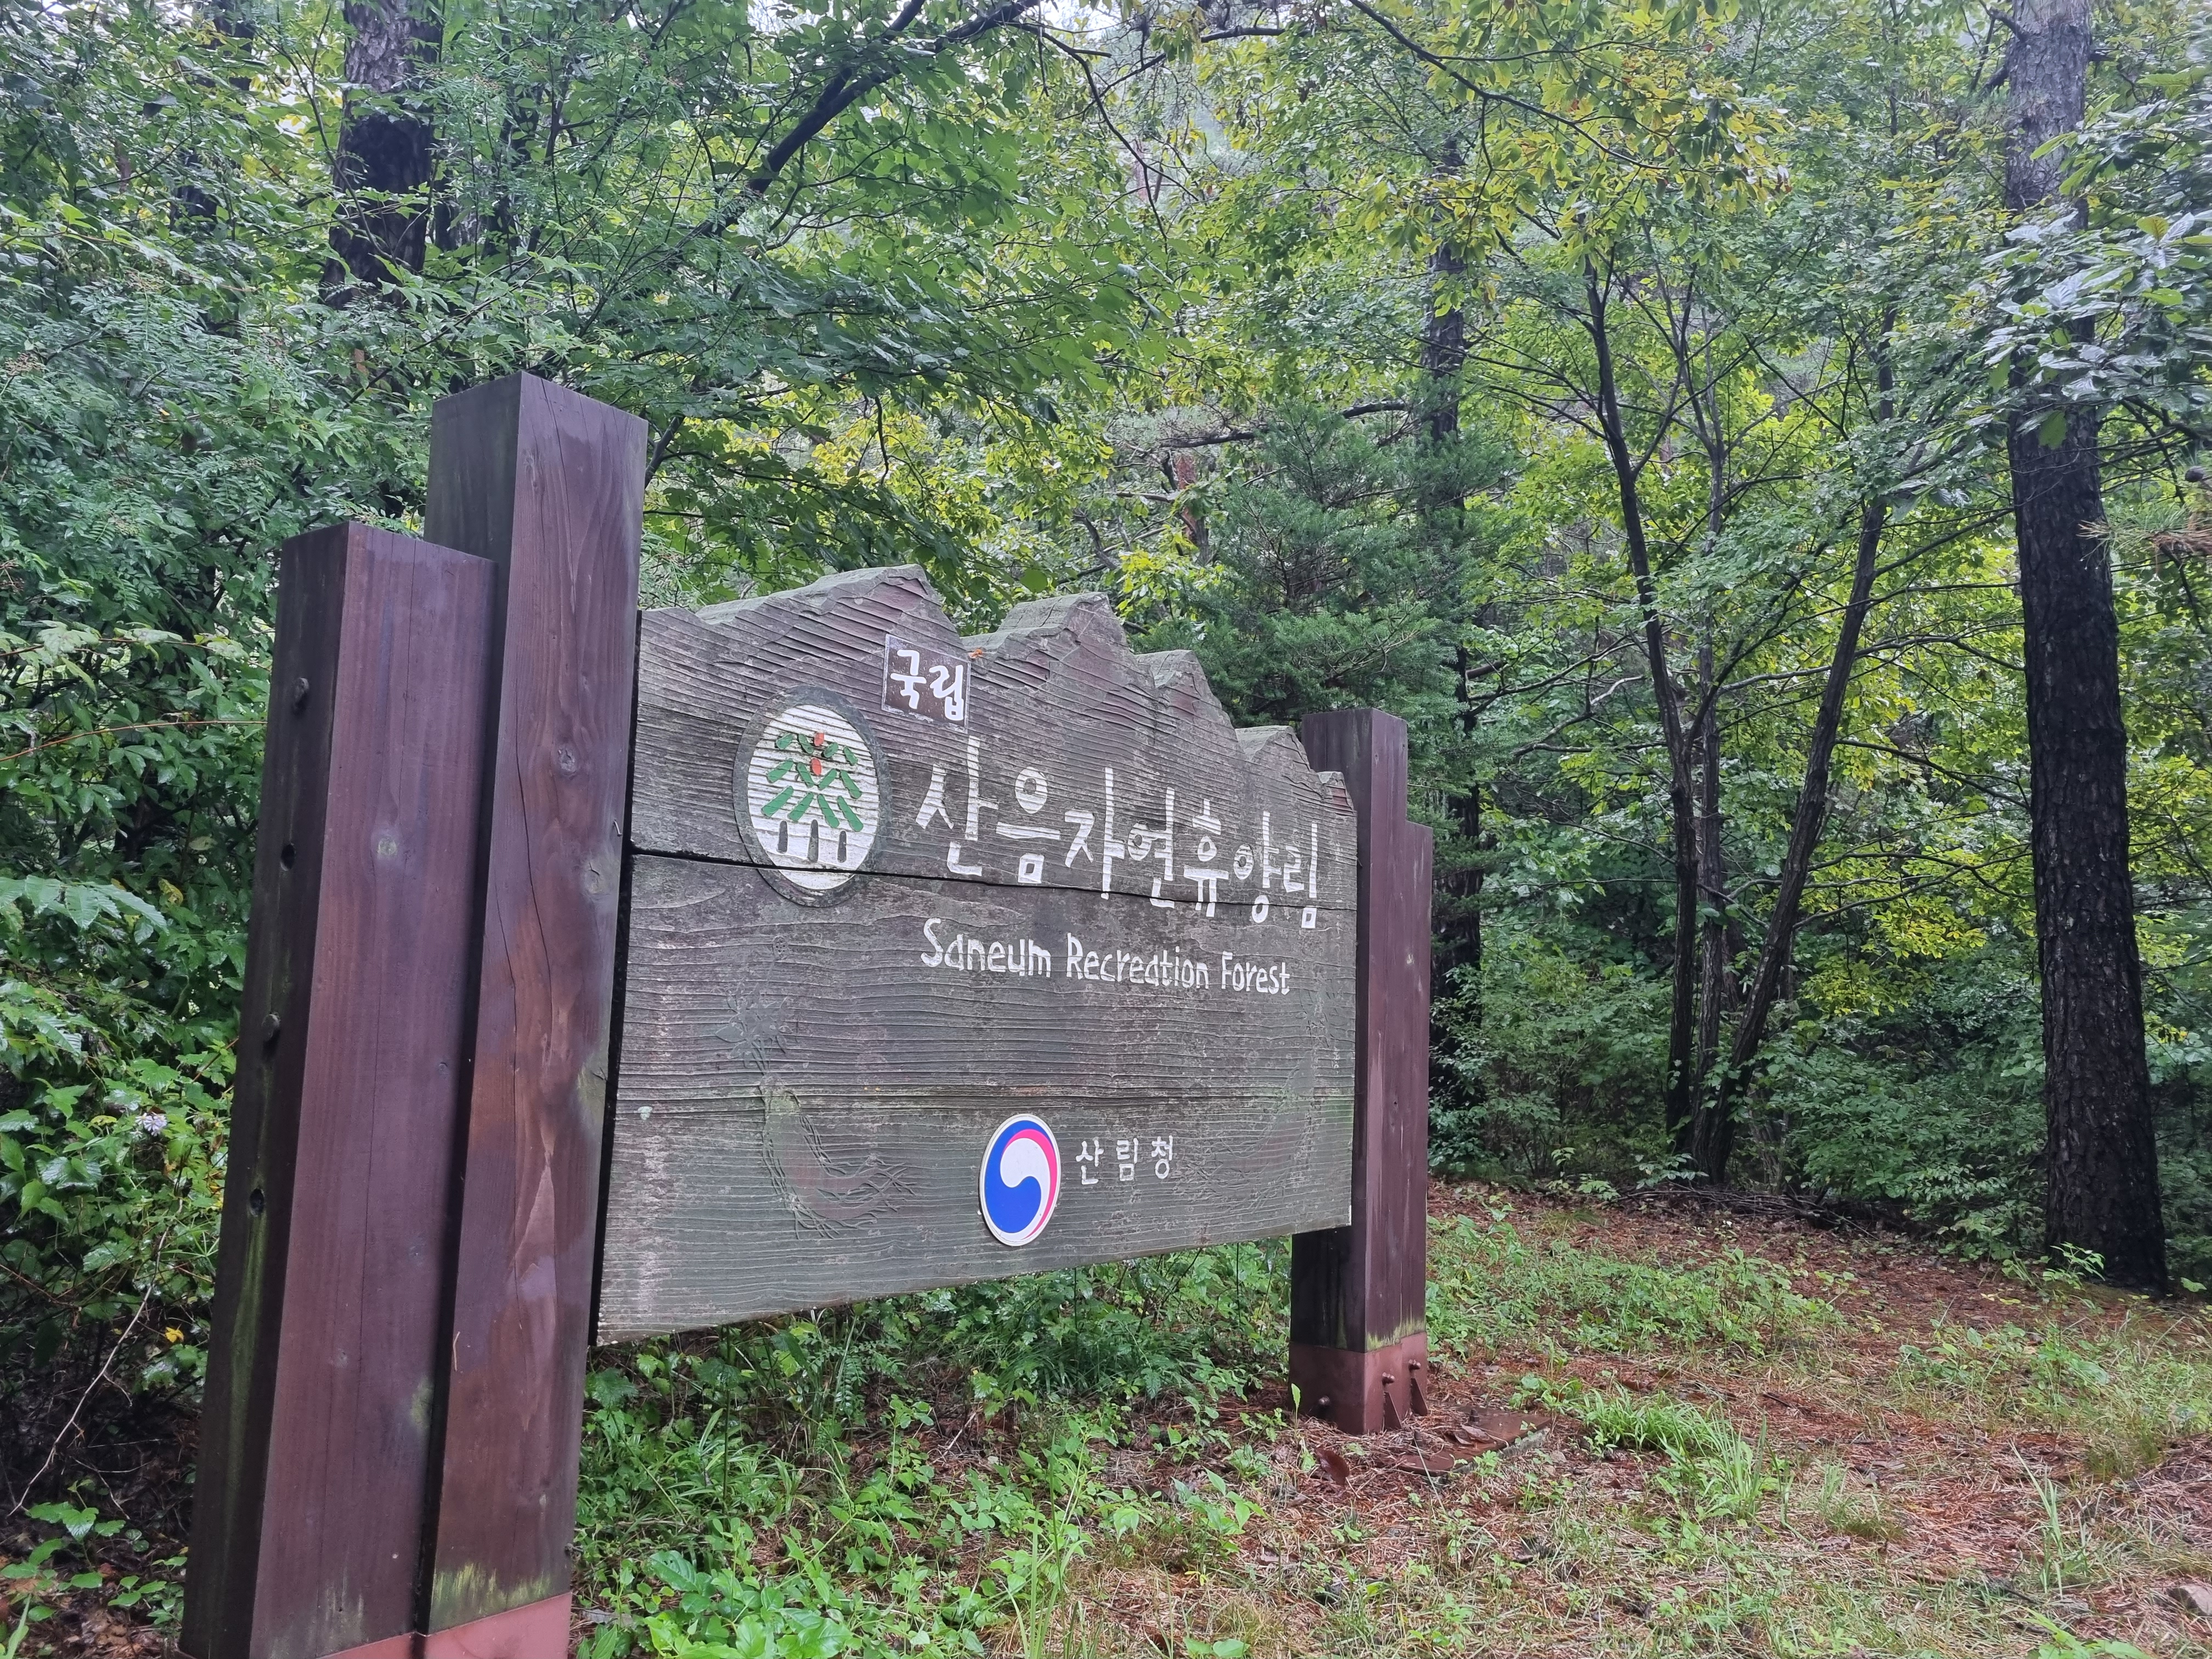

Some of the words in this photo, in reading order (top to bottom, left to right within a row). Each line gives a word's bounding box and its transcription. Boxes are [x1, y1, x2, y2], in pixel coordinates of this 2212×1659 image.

[890, 649, 964, 721] 국립
[915, 735, 1318, 928] 산음자연휴양림
[921, 917, 1052, 978] Saneum
[1066, 932, 1210, 989] Recreation
[1221, 950, 1290, 995] Forest
[1075, 1135, 1173, 1186] 산림청
